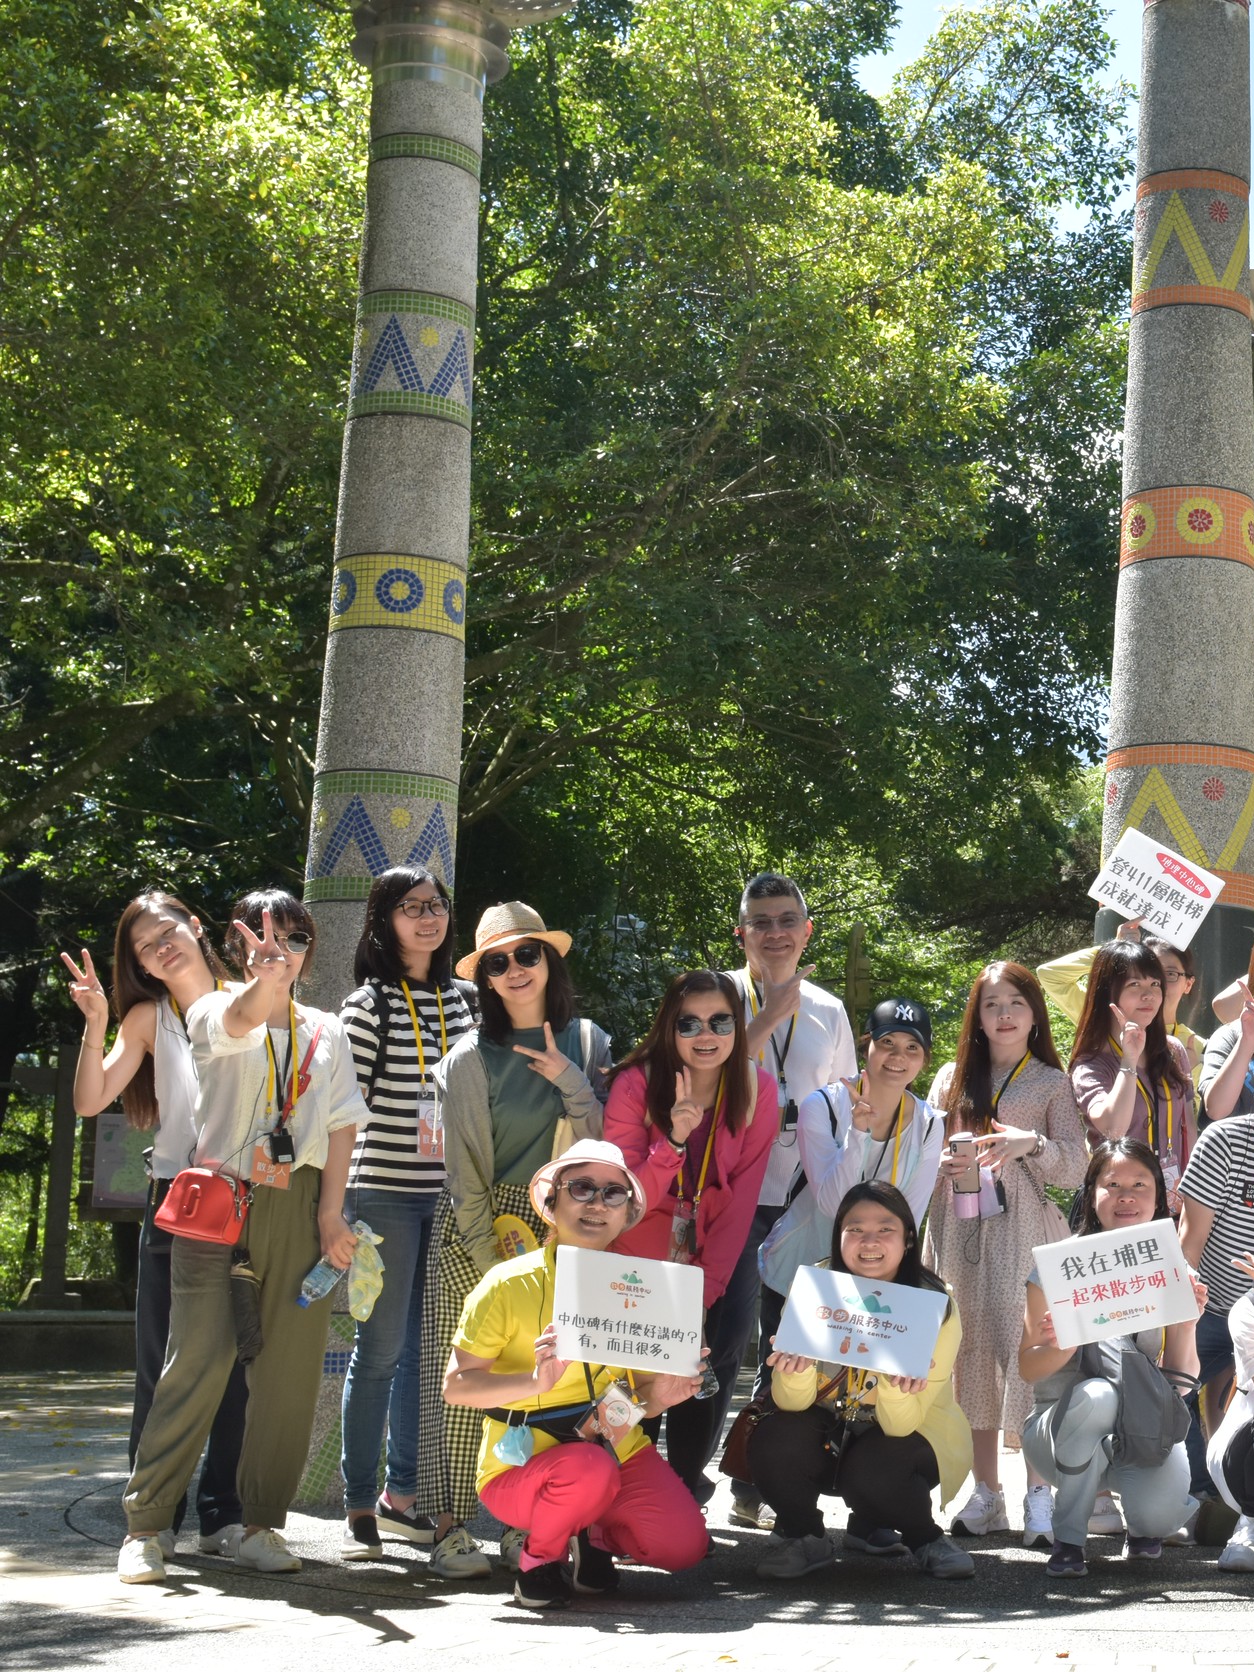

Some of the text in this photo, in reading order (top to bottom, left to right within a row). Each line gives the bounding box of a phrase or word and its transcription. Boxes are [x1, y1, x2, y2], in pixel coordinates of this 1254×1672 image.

[1109, 856, 1204, 920] 登411層階梯
[1162, 857, 1206, 895] 地理中心碑
[894, 1004, 914, 1022] NY
[1060, 1238, 1164, 1281] 我在埔里
[1053, 1267, 1181, 1308] 一起來散步呀！
[816, 1305, 908, 1333] 散步服務中心
[827, 1323, 853, 1334] walking
[867, 1331, 892, 1340] center
